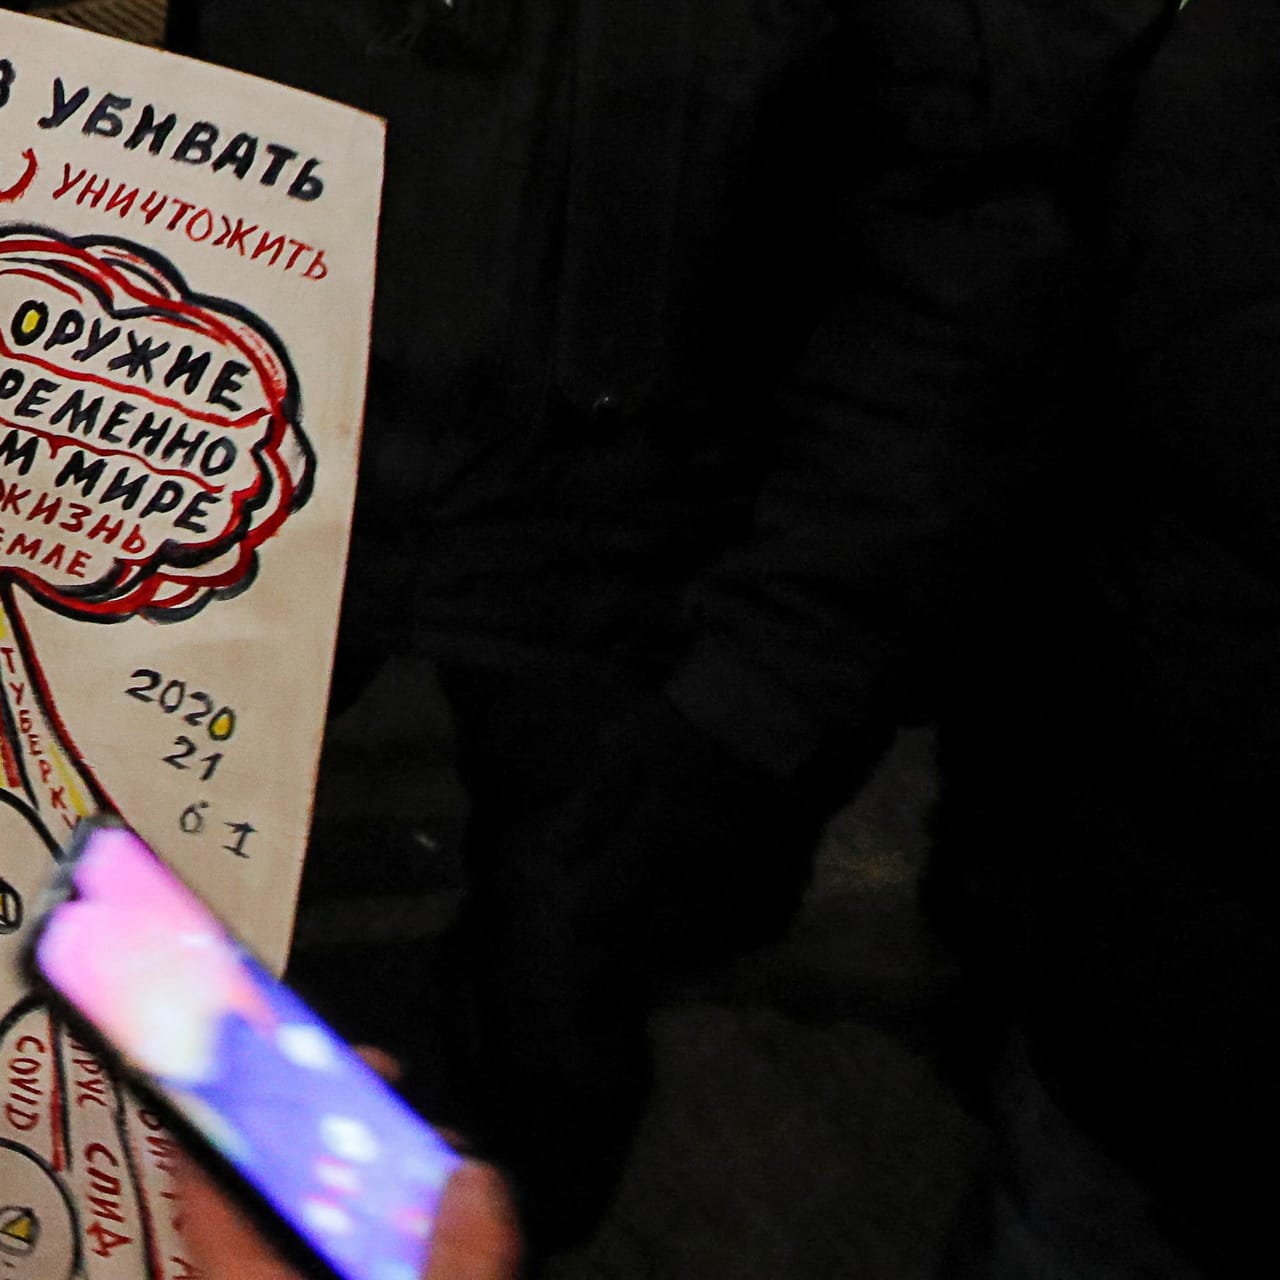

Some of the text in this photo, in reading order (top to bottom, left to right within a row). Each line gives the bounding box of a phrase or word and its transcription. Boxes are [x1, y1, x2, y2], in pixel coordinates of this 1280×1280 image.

[38, 78, 323, 201] УБИВАТЬ
[53, 164, 328, 281] УНИЧТОЖИТЬ
[11, 300, 250, 412] ОРУЖИЕ
[55, 450, 221, 533] МИРЕ
[125, 669, 236, 741] 2020
[162, 736, 224, 781] 21
